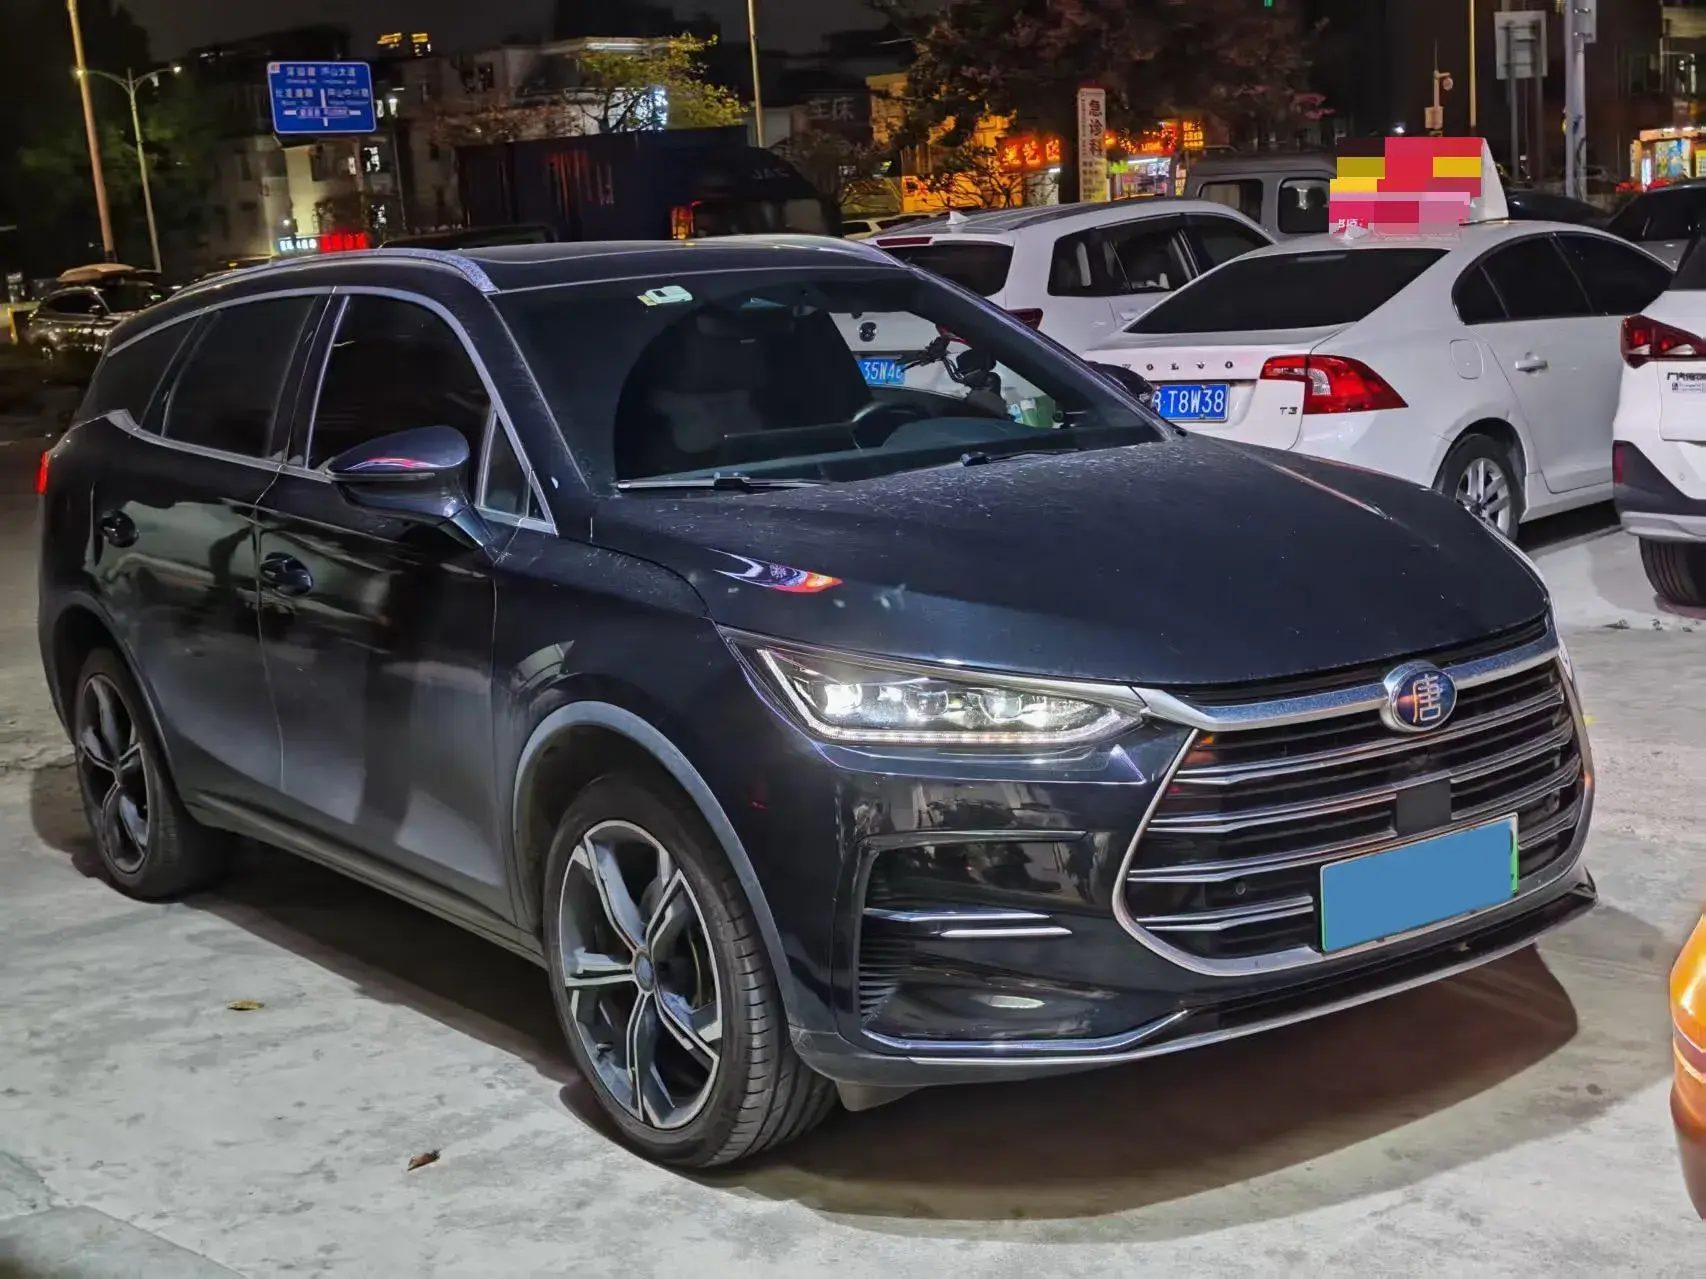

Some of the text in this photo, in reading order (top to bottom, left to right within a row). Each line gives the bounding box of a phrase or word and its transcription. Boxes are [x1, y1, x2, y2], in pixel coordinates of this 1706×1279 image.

[1089, 100, 1103, 156] 急诊科
[1279, 406, 1298, 416] T3
[1412, 673, 1444, 723] 唐
